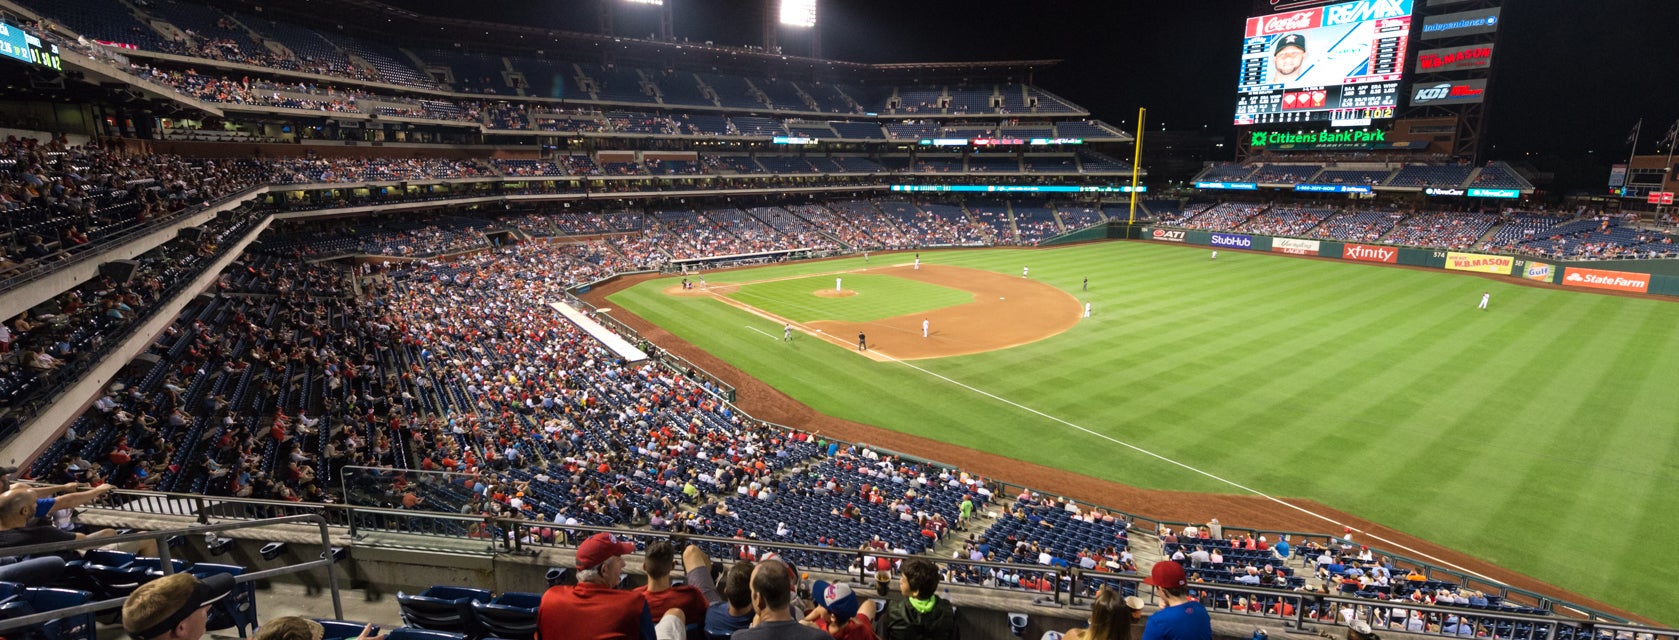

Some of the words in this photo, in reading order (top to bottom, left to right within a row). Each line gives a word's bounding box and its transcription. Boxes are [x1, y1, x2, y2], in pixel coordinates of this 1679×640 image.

[1327, 0, 1405, 25] RE/MAX
[1265, 11, 1315, 33] Coca-Cola
[1269, 132, 1317, 143] Citizens
[1319, 131, 1352, 143] Bank
[1354, 129, 1385, 141] Park
[1163, 230, 1186, 239] ATI
[1211, 234, 1251, 247] StubHub
[1346, 246, 1394, 262] xfinity
[1528, 267, 1549, 276] Gulf
